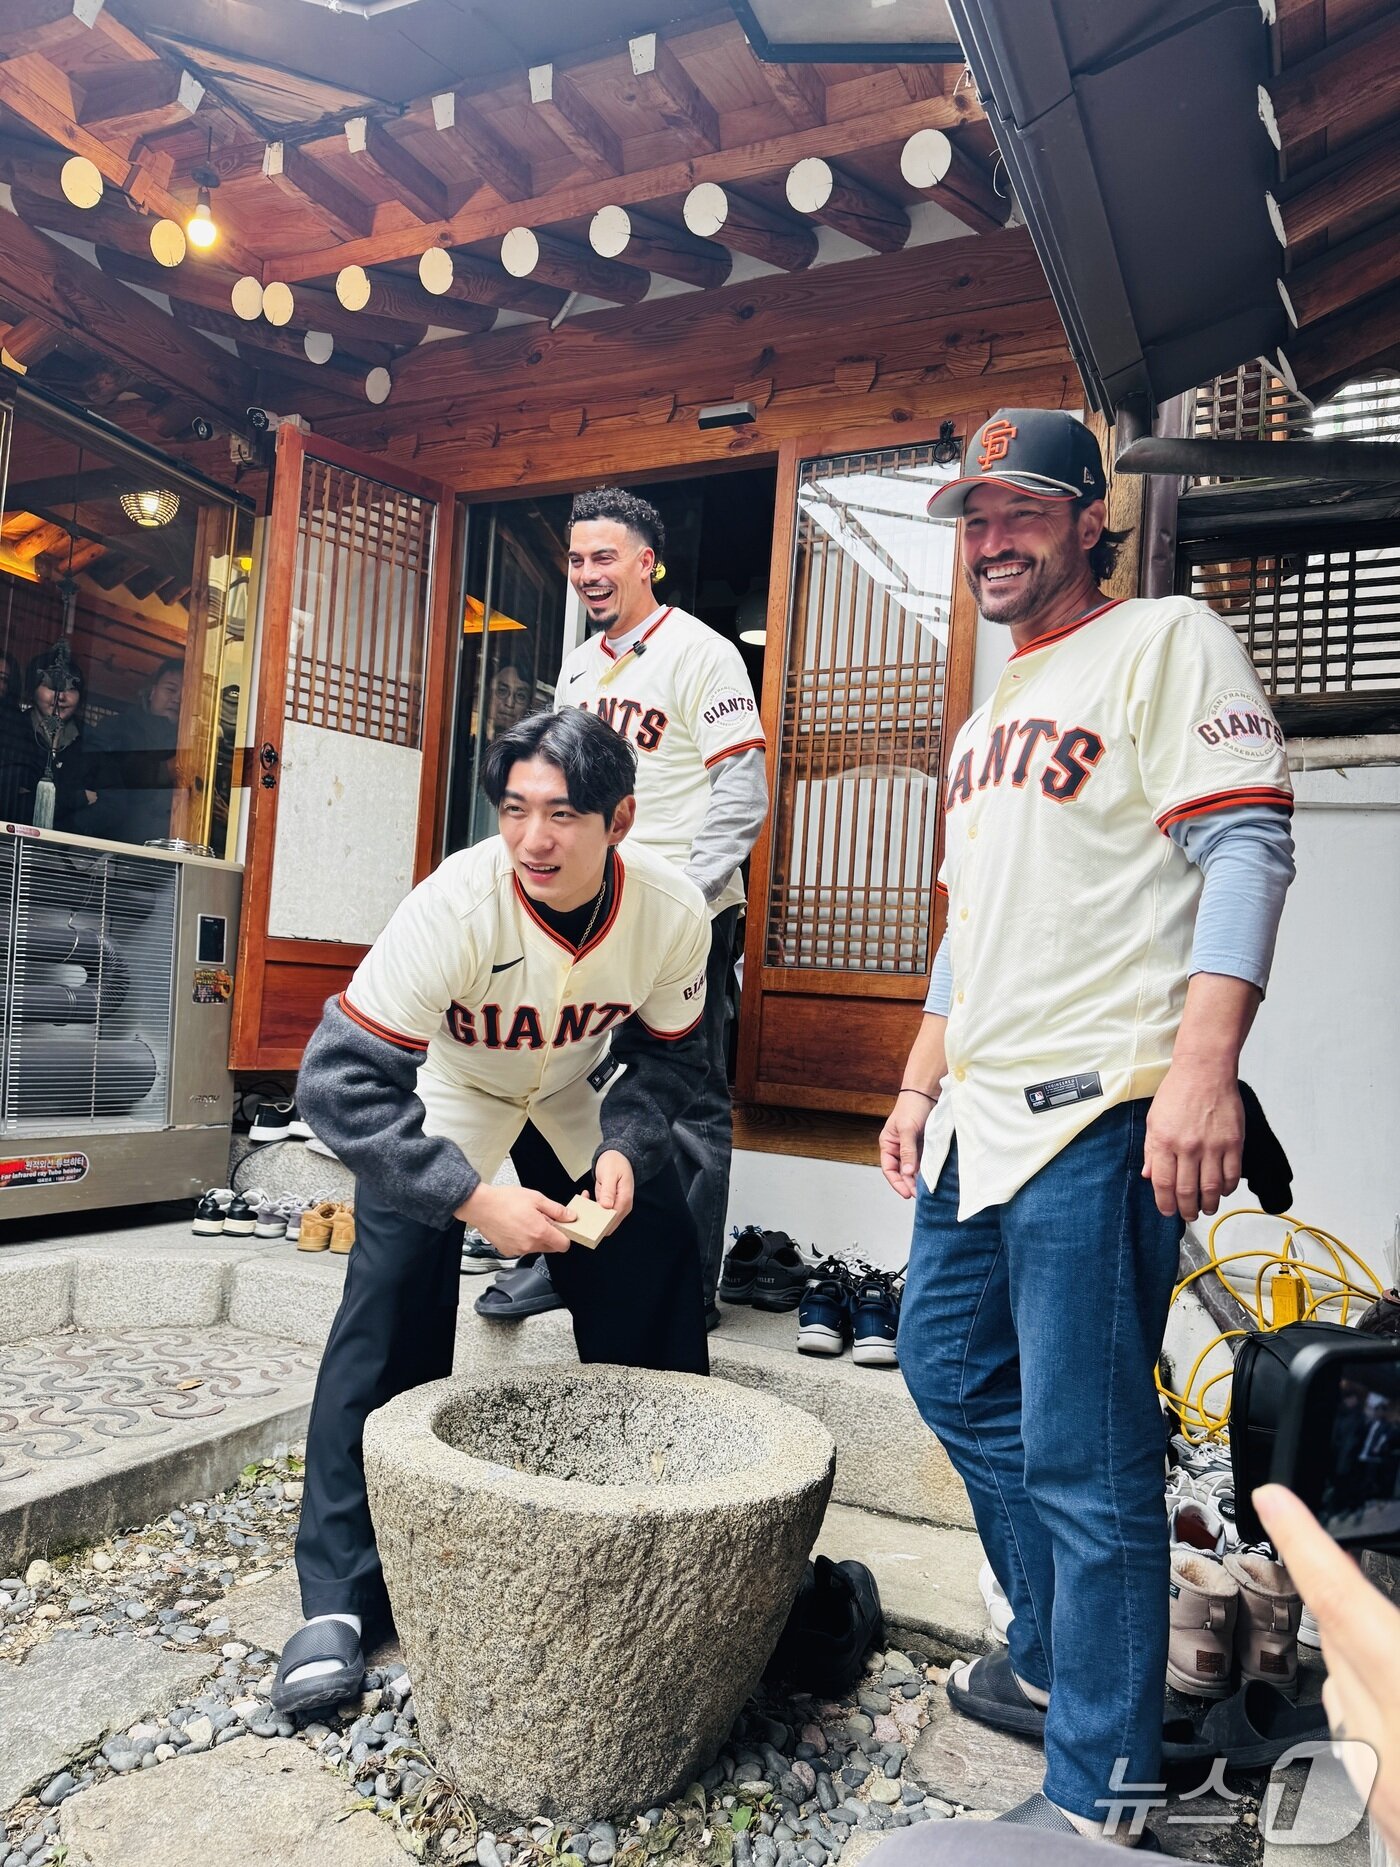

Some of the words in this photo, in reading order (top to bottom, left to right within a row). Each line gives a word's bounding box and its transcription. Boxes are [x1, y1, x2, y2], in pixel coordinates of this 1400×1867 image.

[579, 697, 670, 753] NTS
[703, 697, 754, 724] GIANTS
[1197, 713, 1283, 746] GIANTS
